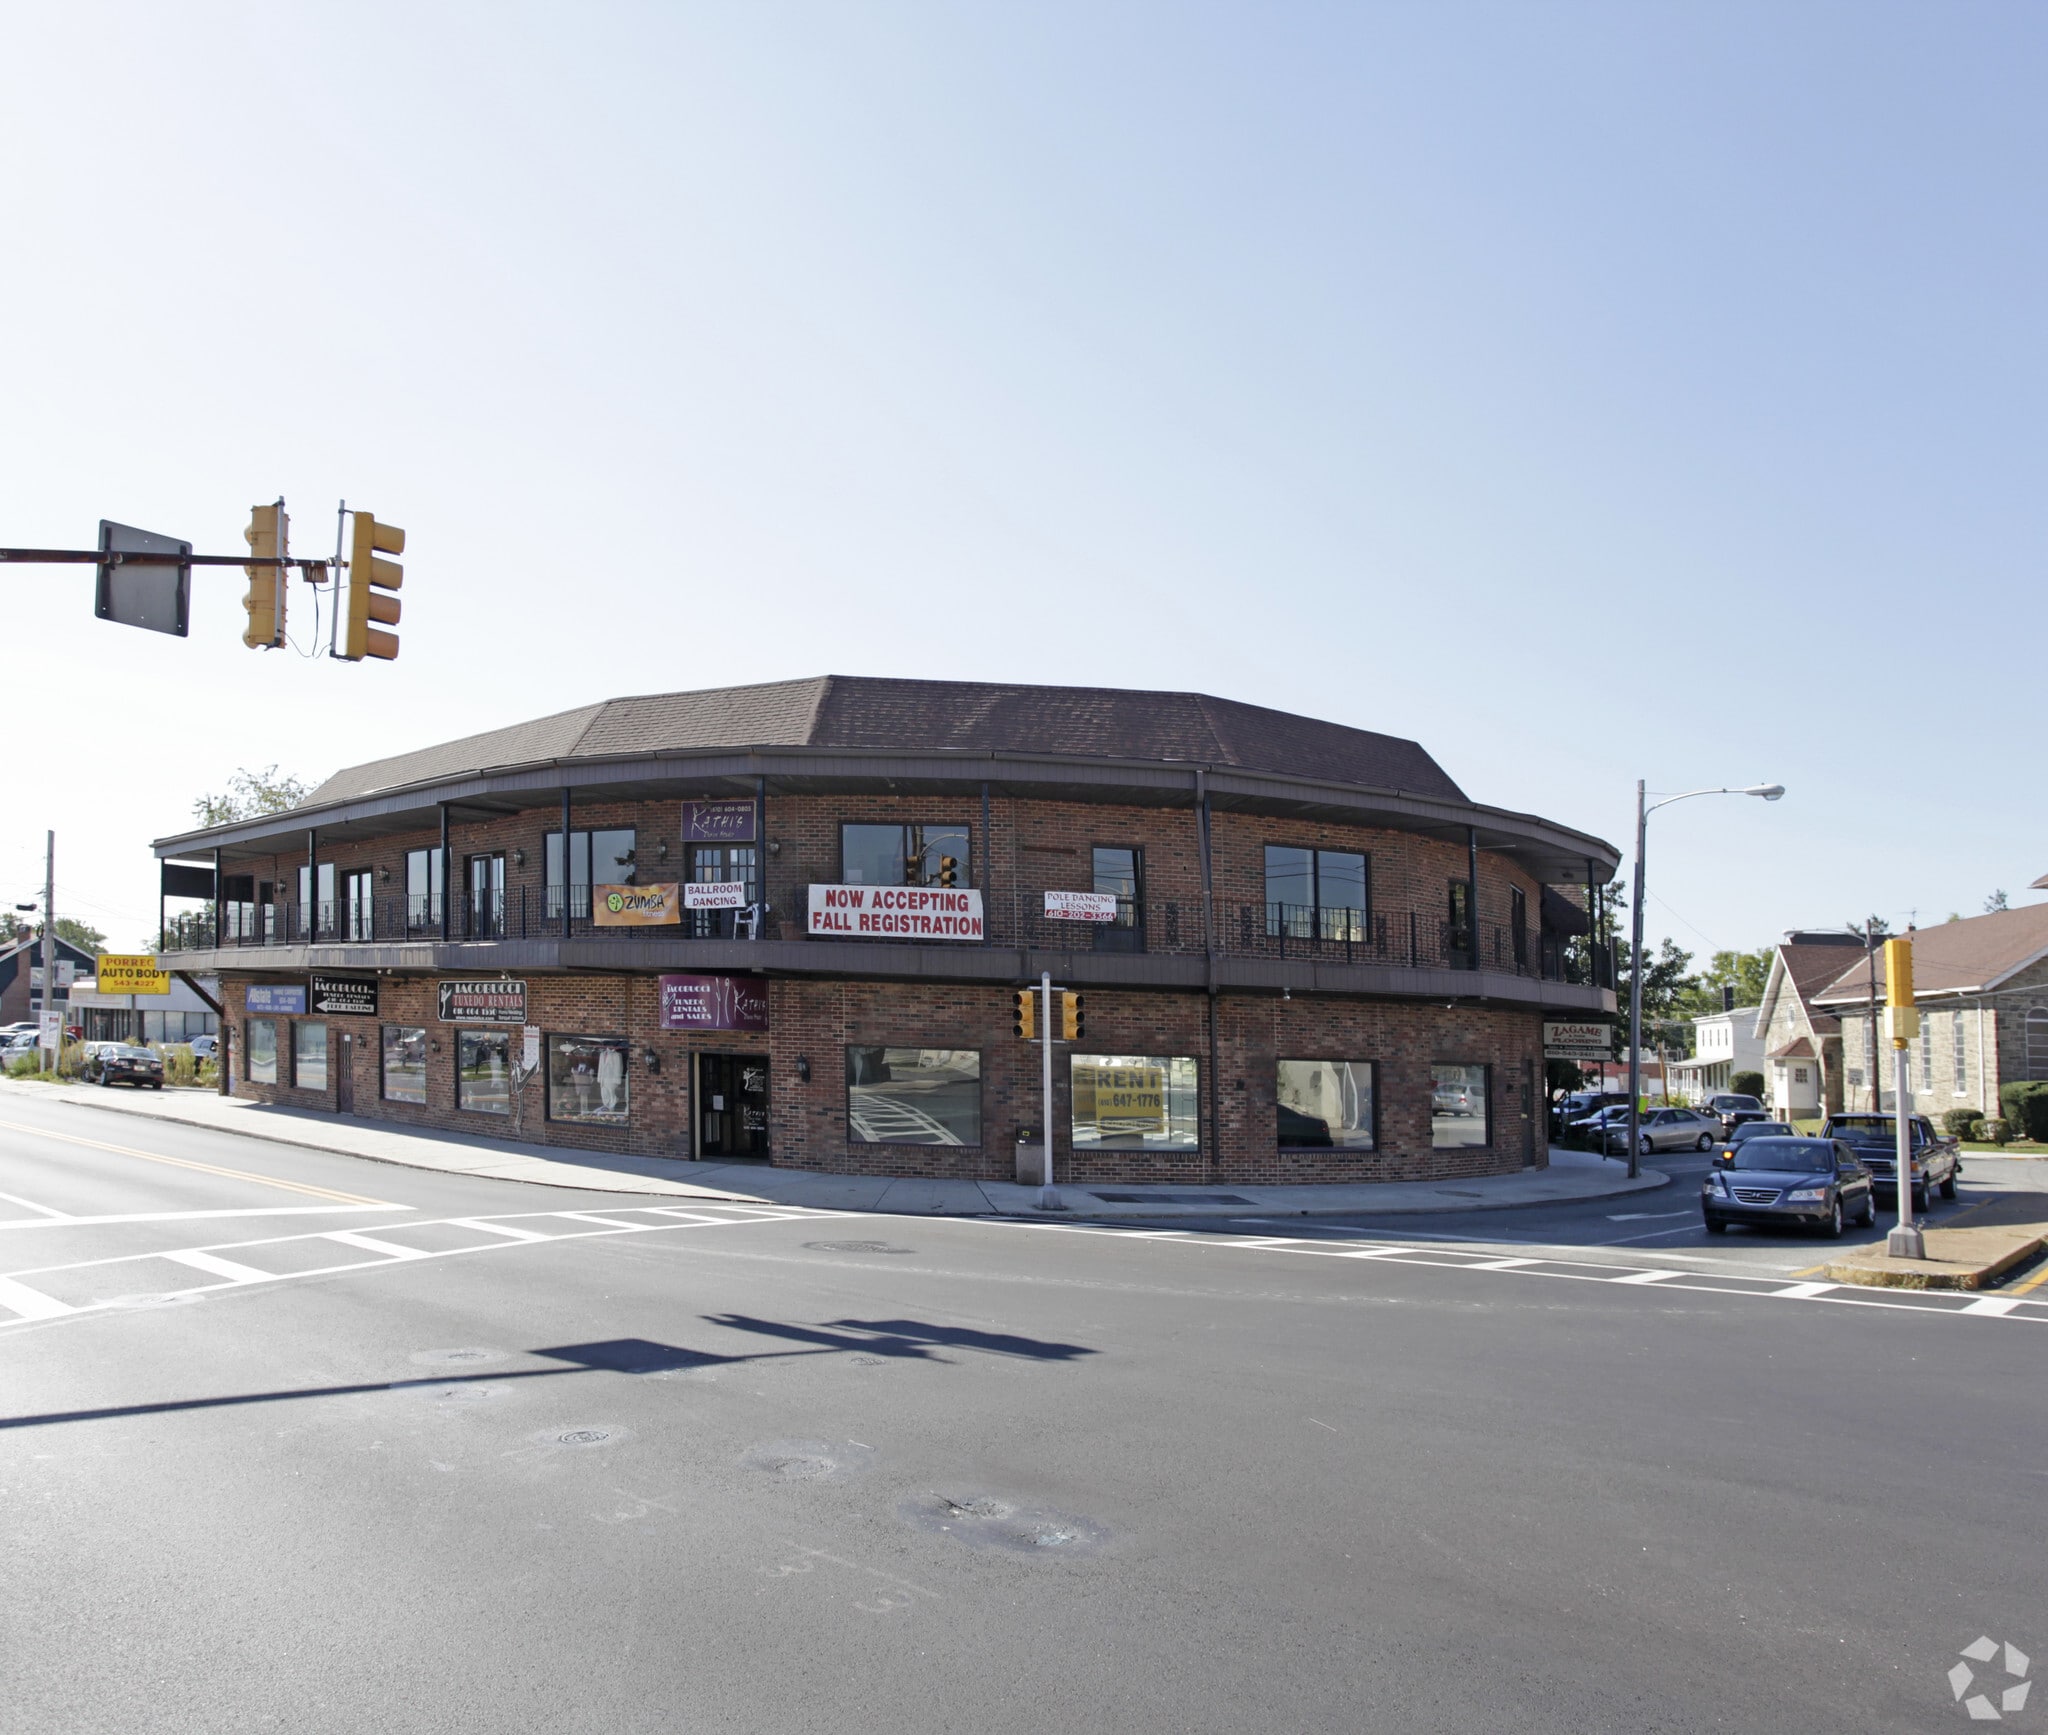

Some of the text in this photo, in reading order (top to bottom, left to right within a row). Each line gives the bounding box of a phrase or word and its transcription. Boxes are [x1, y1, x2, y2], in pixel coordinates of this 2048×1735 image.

[688, 884, 742, 895] BALLROOM
[625, 894, 665, 910] ZUMBA
[692, 896, 737, 907] DANCING
[825, 889, 969, 912] NOW ACCEPTING
[1047, 892, 1114, 904] POLE DANCING
[1060, 902, 1101, 911] LESSONS
[642, 909, 665, 918] fitness
[812, 911, 982, 936] FALL REGISTRATION
[101, 968, 167, 979] AUTO BODY
[315, 982, 368, 994] IACOBUCCI
[455, 983, 521, 994] IACOBUCCI
[453, 995, 523, 1008] TUXEDO RENTALS
[1551, 1025, 1603, 1037] ZAGAME
[1552, 1037, 1603, 1045] FLOORING
[1097, 1070, 1160, 1089] RENT
[1113, 1093, 1160, 1108] 647-1776
